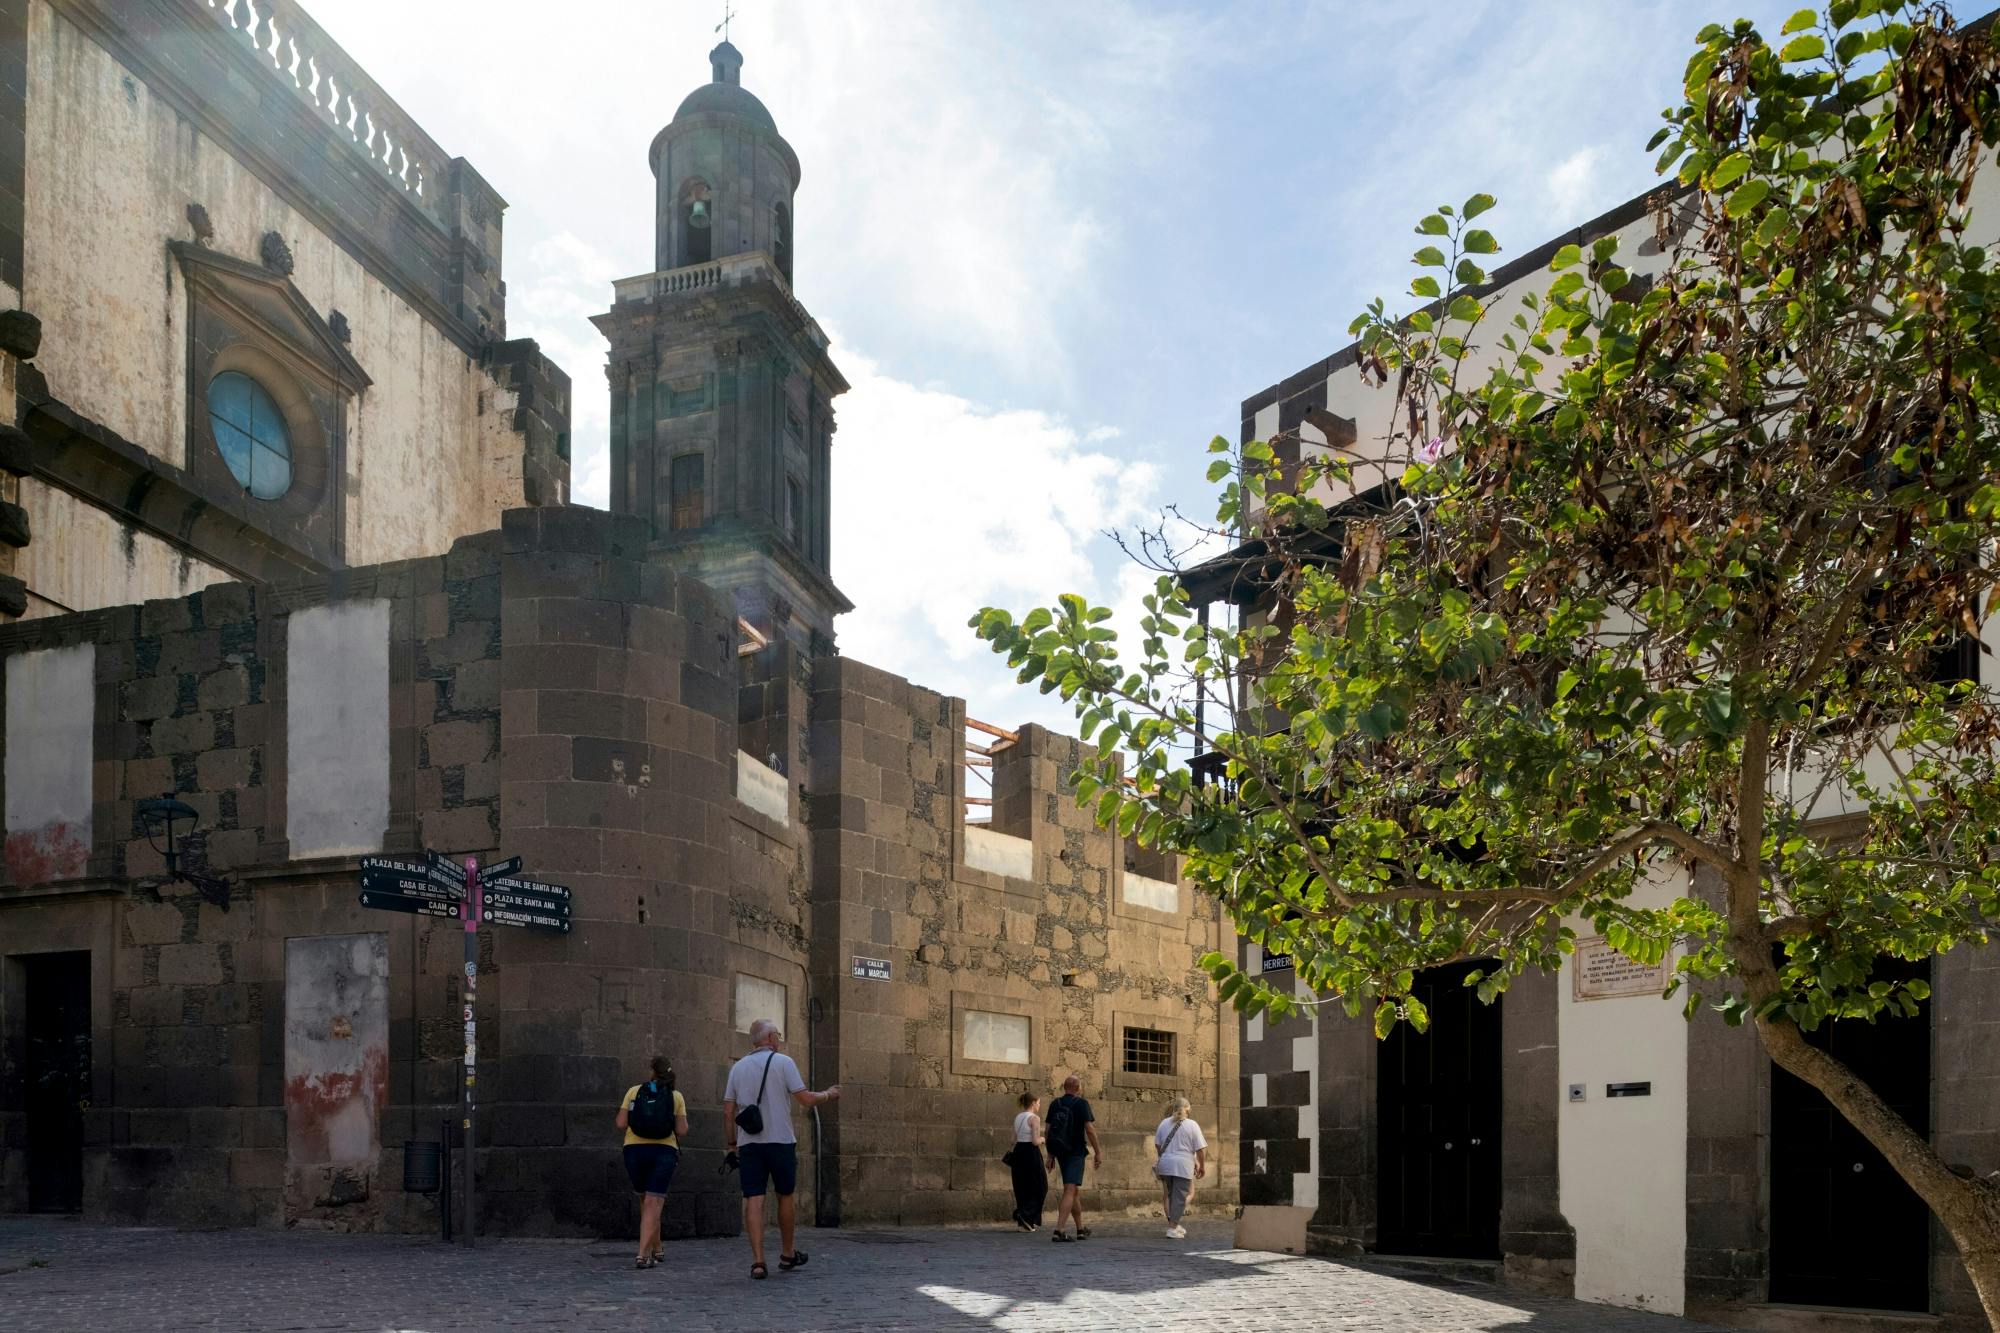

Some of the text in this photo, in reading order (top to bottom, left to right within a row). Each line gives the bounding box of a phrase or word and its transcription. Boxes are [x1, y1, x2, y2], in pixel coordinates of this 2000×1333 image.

[370, 858, 392, 868] PLAZA
[394, 862, 406, 871] DEL
[407, 864, 426, 874] PILAR
[400, 880, 417, 889] CASA
[418, 883, 427, 891] DE
[495, 878, 522, 888] CATEDRAL
[524, 881, 531, 890] DE
[532, 883, 550, 893] SANTA
[551, 886, 563, 895] ANA
[429, 901, 447, 910] CAAM
[495, 894, 514, 903] PLAZA
[515, 897, 523, 905] DE
[524, 898, 542, 908] SANTA
[543, 901, 556, 910] ANA
[495, 911, 560, 926] INFORMACIÓN TURÍSTICA
[867, 960, 884, 968] CALLE
[854, 967, 889, 978] SAN MARCIAL
